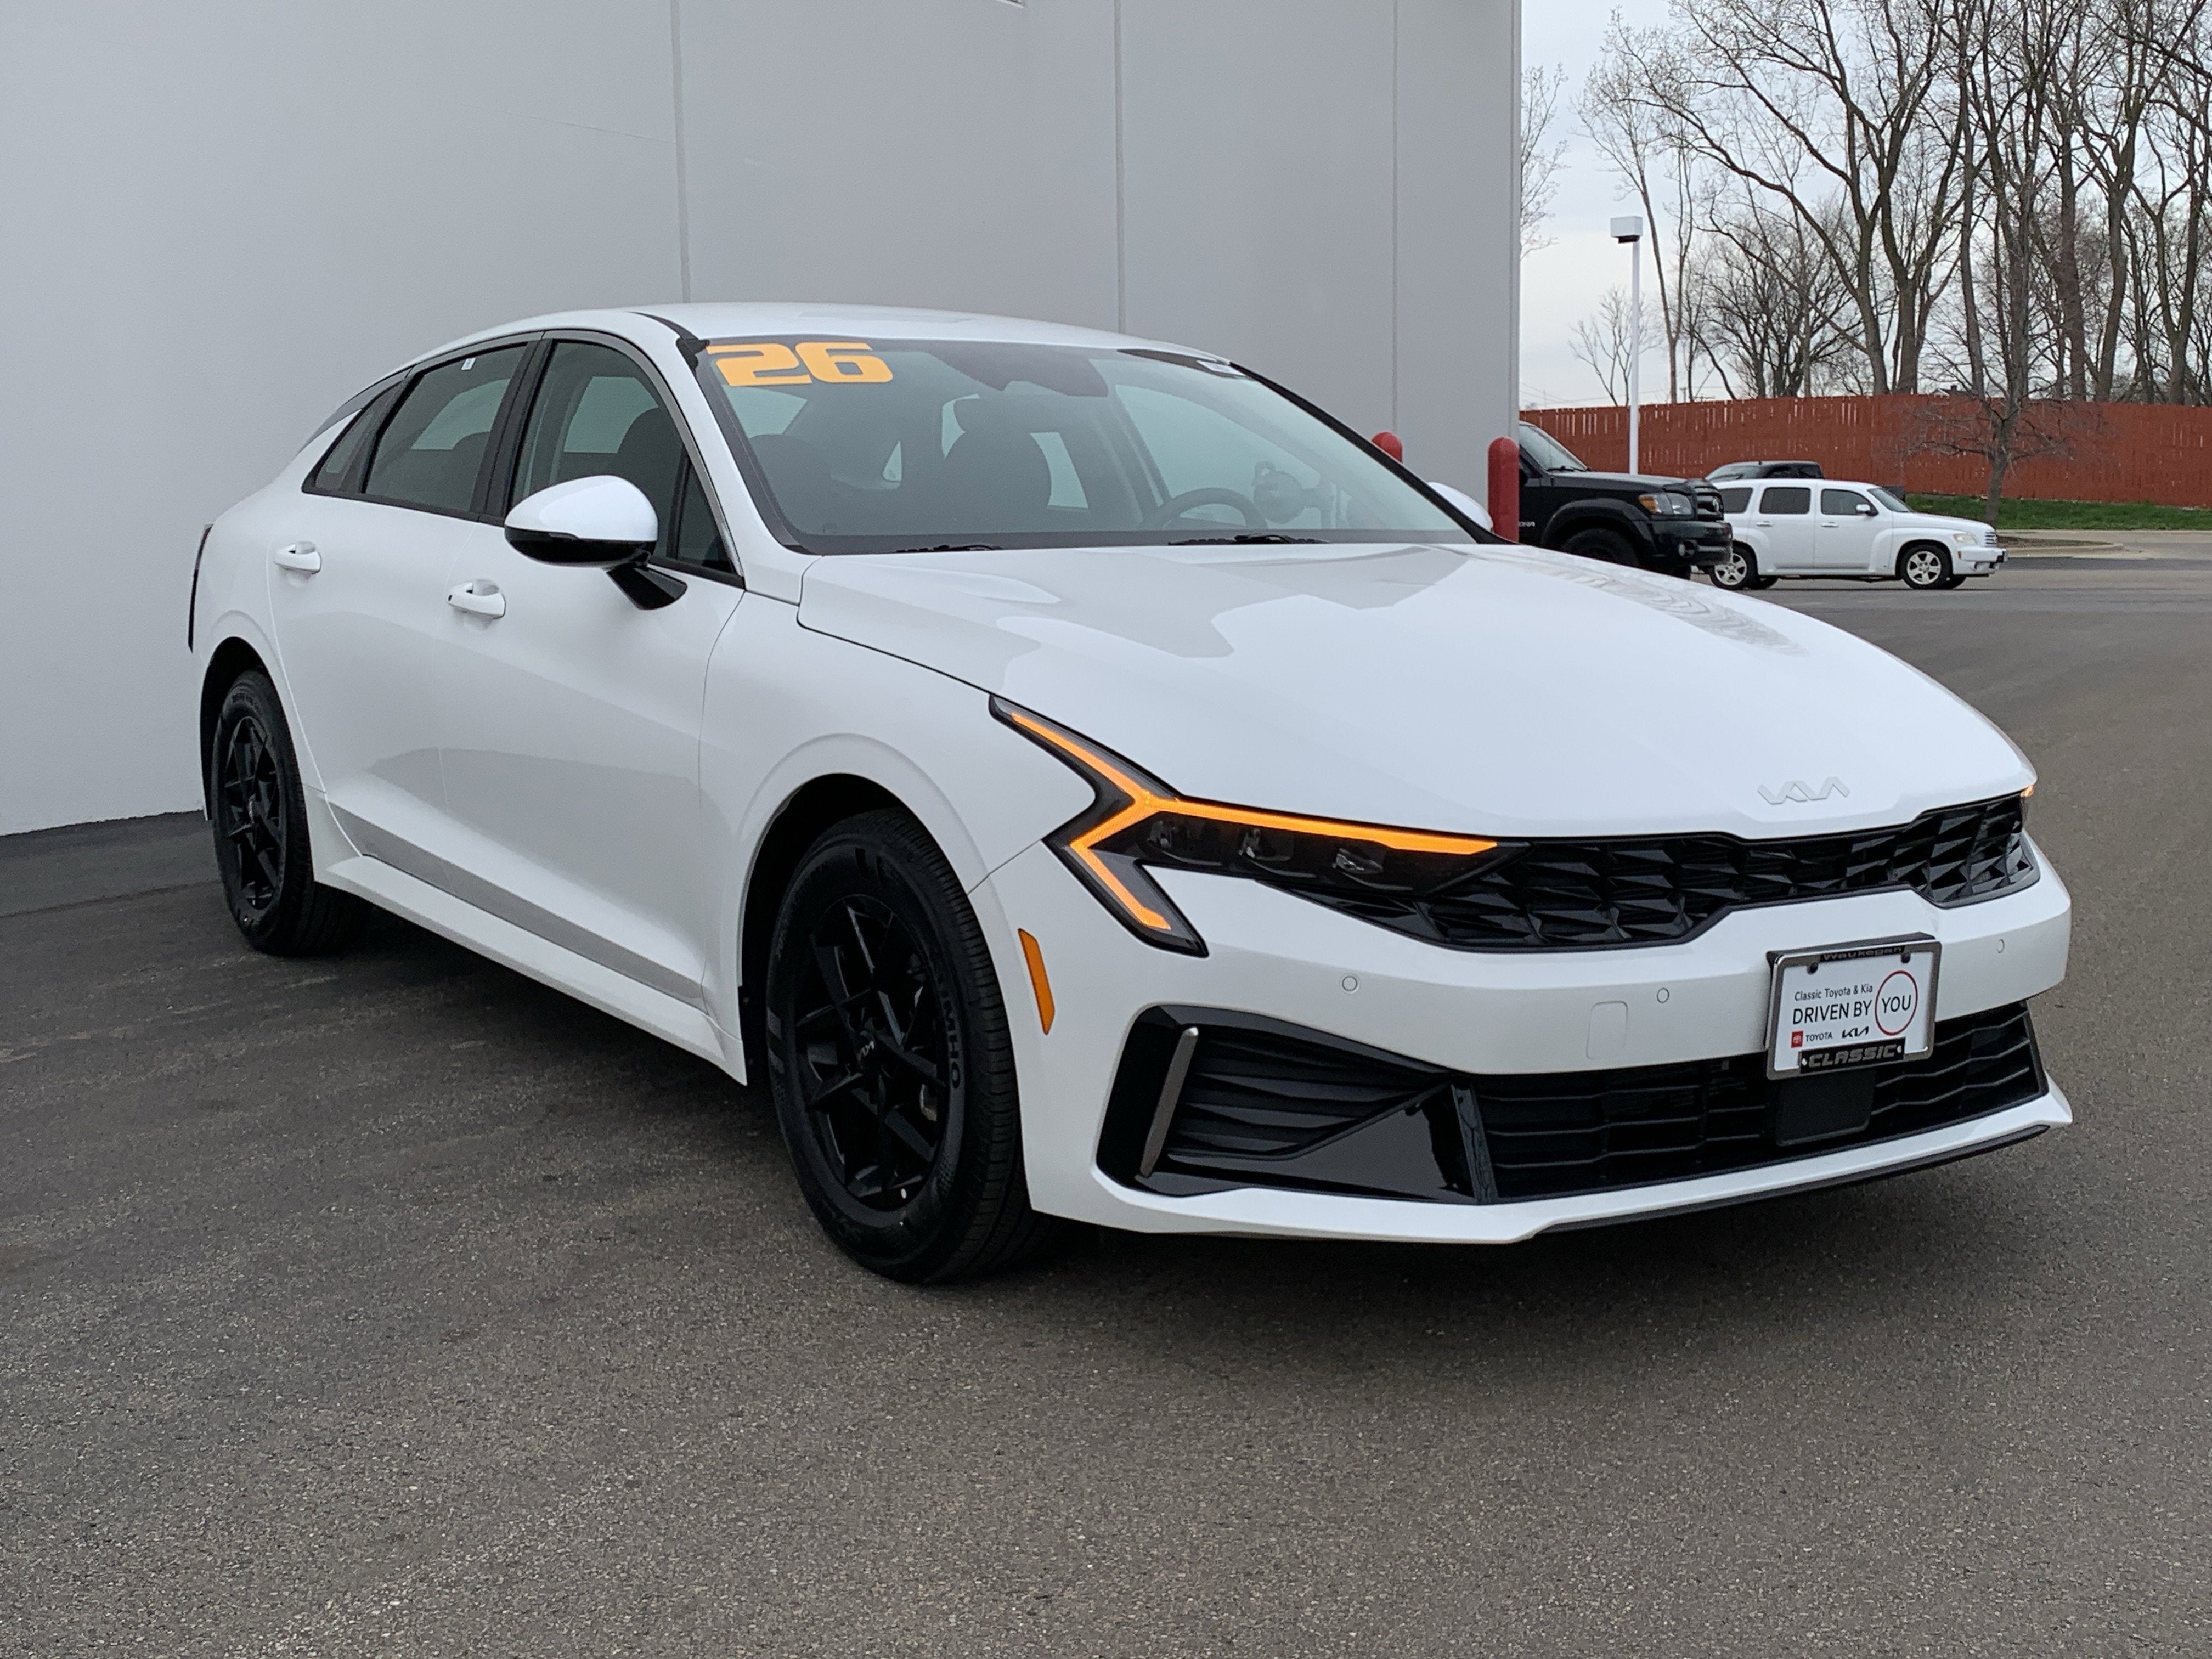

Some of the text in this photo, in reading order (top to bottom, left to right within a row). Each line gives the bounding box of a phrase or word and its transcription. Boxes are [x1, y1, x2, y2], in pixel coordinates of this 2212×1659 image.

[706, 342, 893, 387] 26
[1823, 947, 1902, 960] Waukegan
[1795, 984, 1873, 1001] Classic Toyota & Kia
[1793, 995, 1911, 1024] DRIVEN BY YOU
[1805, 1032, 1832, 1042] TOYOTA
[1842, 1026, 1869, 1039] KIA
[1808, 1044, 1897, 1067] CLASSIC
